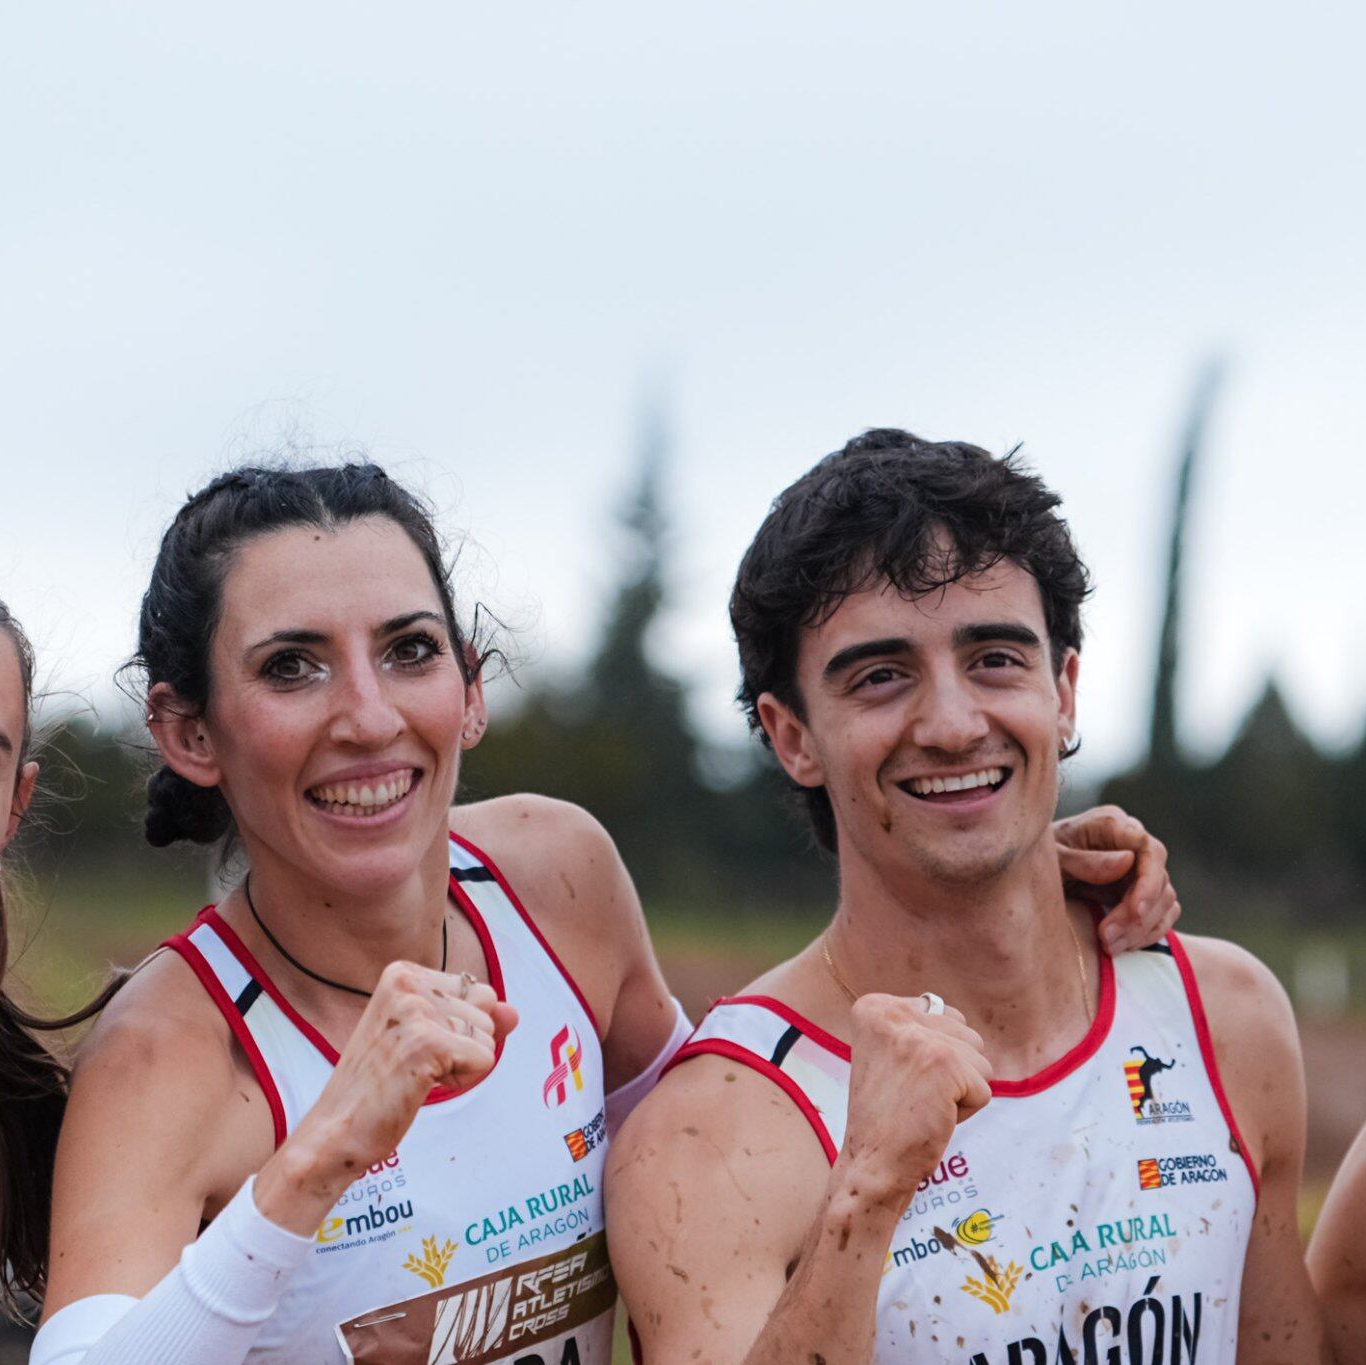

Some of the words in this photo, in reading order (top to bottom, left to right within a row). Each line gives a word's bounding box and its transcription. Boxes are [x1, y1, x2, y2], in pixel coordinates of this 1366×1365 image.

[1149, 1099, 1190, 1115] ARAGÓN
[1158, 1154, 1216, 1172] GOBIERNO
[1160, 1173, 1176, 1187] DE
[337, 1175, 406, 1206] GUROS
[317, 1200, 413, 1243] embou
[465, 1206, 523, 1246] CAJA
[525, 1173, 594, 1221] RURAL
[316, 1240, 366, 1254] conectando
[369, 1231, 395, 1244] Aragón
[486, 1244, 512, 1264] DE
[518, 1208, 589, 1253] ARAGÓN
[1030, 1230, 1091, 1271] CAA
[1097, 1213, 1176, 1248] RURAL
[516, 1251, 588, 1296] RFEA
[1081, 1246, 1166, 1281] ARAGÓN
[509, 1303, 570, 1340] CROSS
